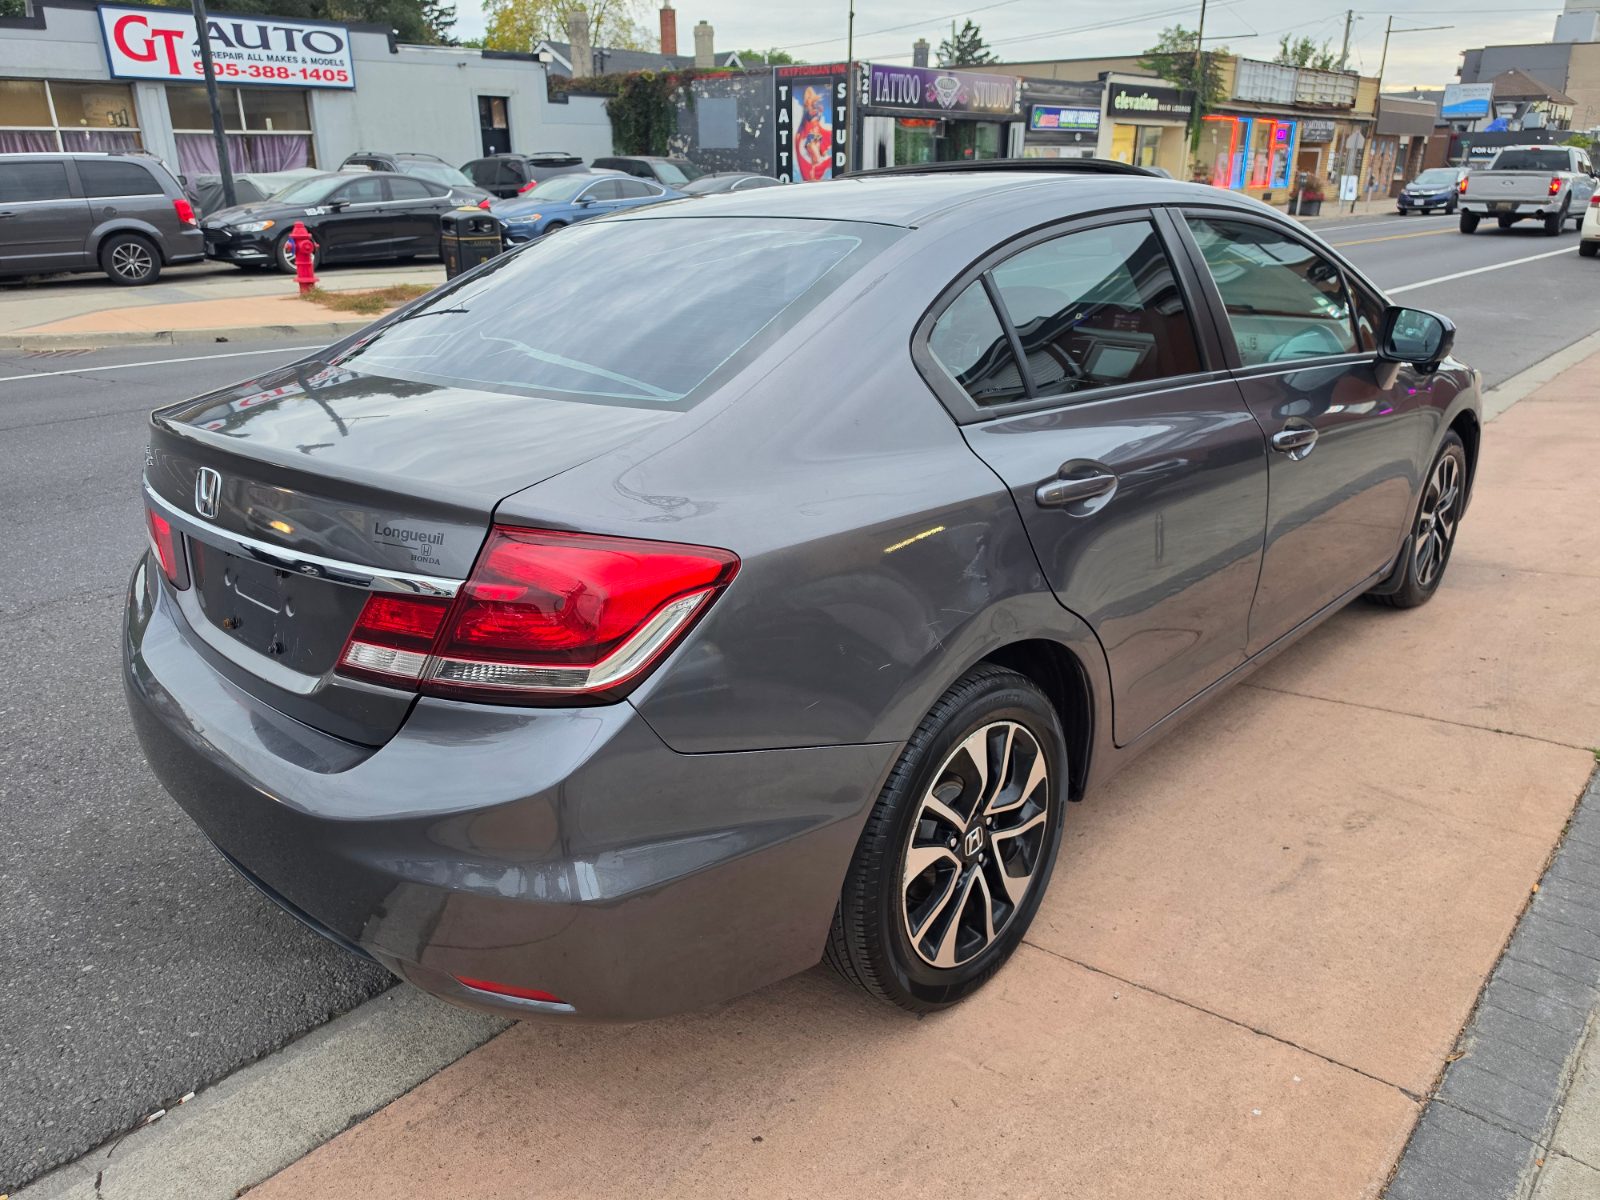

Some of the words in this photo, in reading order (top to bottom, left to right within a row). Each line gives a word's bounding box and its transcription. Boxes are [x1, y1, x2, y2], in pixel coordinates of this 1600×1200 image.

[113, 14, 184, 76] GT
[192, 21, 344, 55] AUTO
[211, 51, 244, 61] REPAIR
[247, 54, 264, 62] ALL
[267, 55, 298, 64] MAKES
[310, 58, 345, 67] MODELS
[193, 61, 348, 82] 905-388-1405
[875, 71, 921, 105] TATTOO
[973, 81, 1012, 109] STUDIO
[1114, 91, 1159, 111] elevation
[778, 86, 790, 184] TATTO
[836, 82, 847, 167] STUD
[374, 522, 445, 546] Longueuil
[411, 554, 441, 566] HONDA
